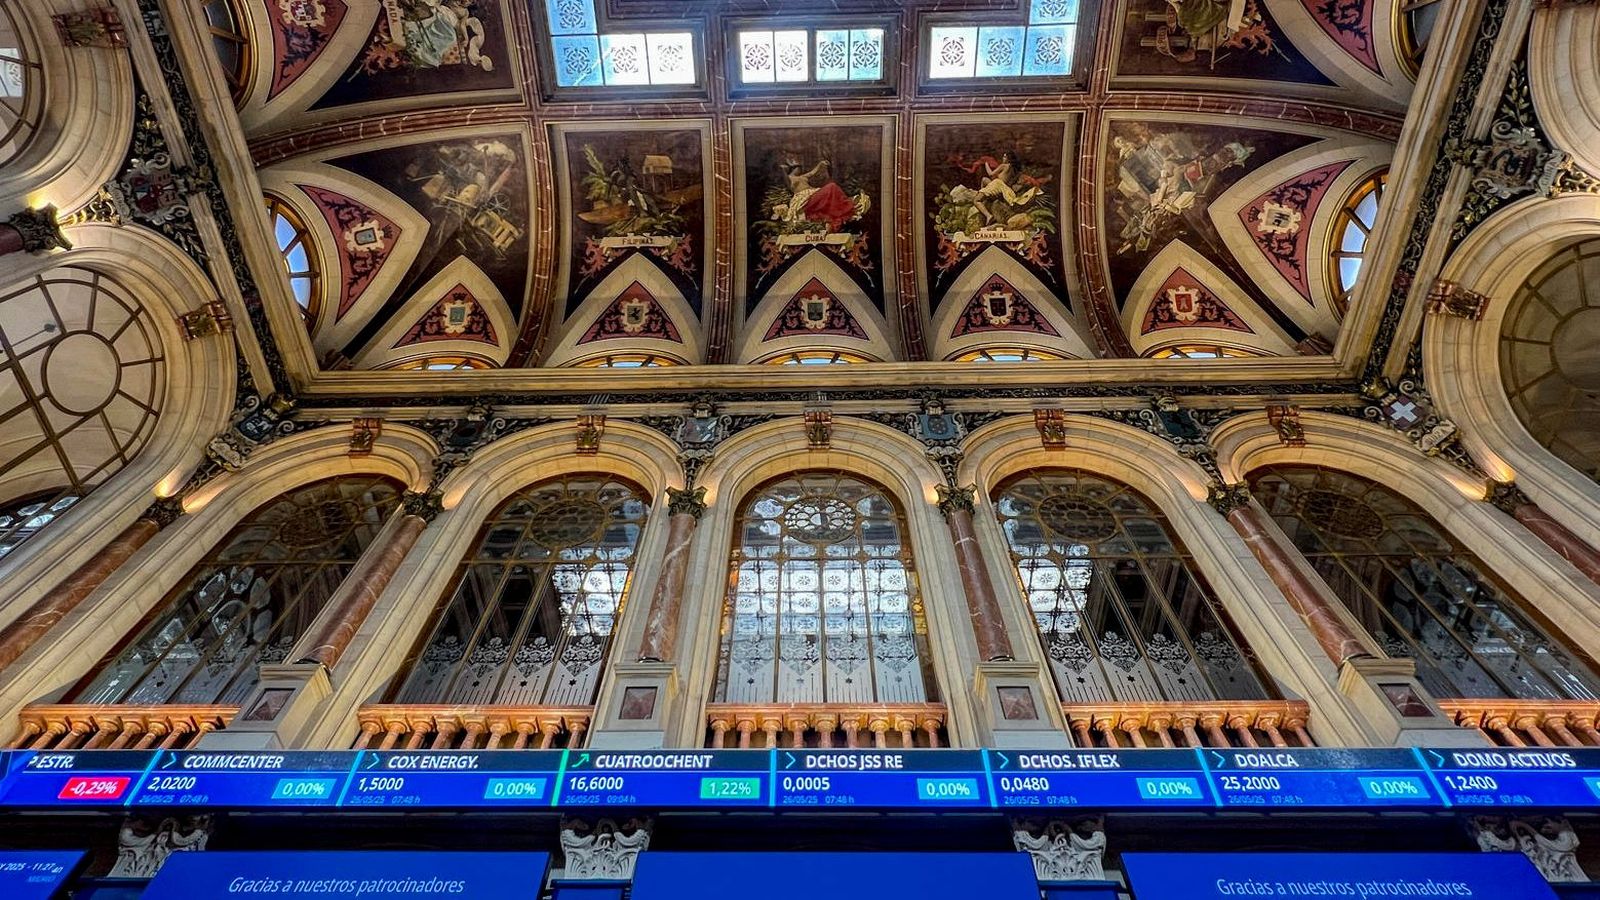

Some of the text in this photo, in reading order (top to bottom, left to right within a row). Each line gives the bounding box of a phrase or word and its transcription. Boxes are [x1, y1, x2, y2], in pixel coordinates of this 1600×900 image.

[183, 755, 284, 769] COMMCENTER
[388, 755, 479, 769] COX ENERGY.
[595, 754, 713, 769] CUATROOCHENT
[805, 754, 904, 771] DCHOS JSS RE
[1018, 754, 1121, 769] DCHOS. IFLEX
[1234, 753, 1300, 768] DOALCA
[1452, 752, 1577, 768] DOMO ACTIVOS
[70, 781, 118, 796] -0,29%
[147, 776, 197, 792] 2,0200
[282, 782, 325, 797] 0,00%
[358, 777, 404, 792] 1,5000
[493, 782, 537, 797] 0,00%
[569, 776, 624, 792] 16,6000
[709, 782, 751, 797] 1,22%
[783, 777, 830, 792] 0,0005
[926, 782, 970, 798] 0,00%
[1000, 777, 1049, 792] 0,0480
[1146, 781, 1192, 797] 0,00%
[1220, 776, 1281, 792] 25,2000
[1370, 781, 1418, 796] 0,00%
[1445, 775, 1498, 791] 1,2400
[228, 876, 465, 897] Gracias a nuestros patrocinadores
[1216, 878, 1473, 900] Gracias a nuestros patrocinadores
